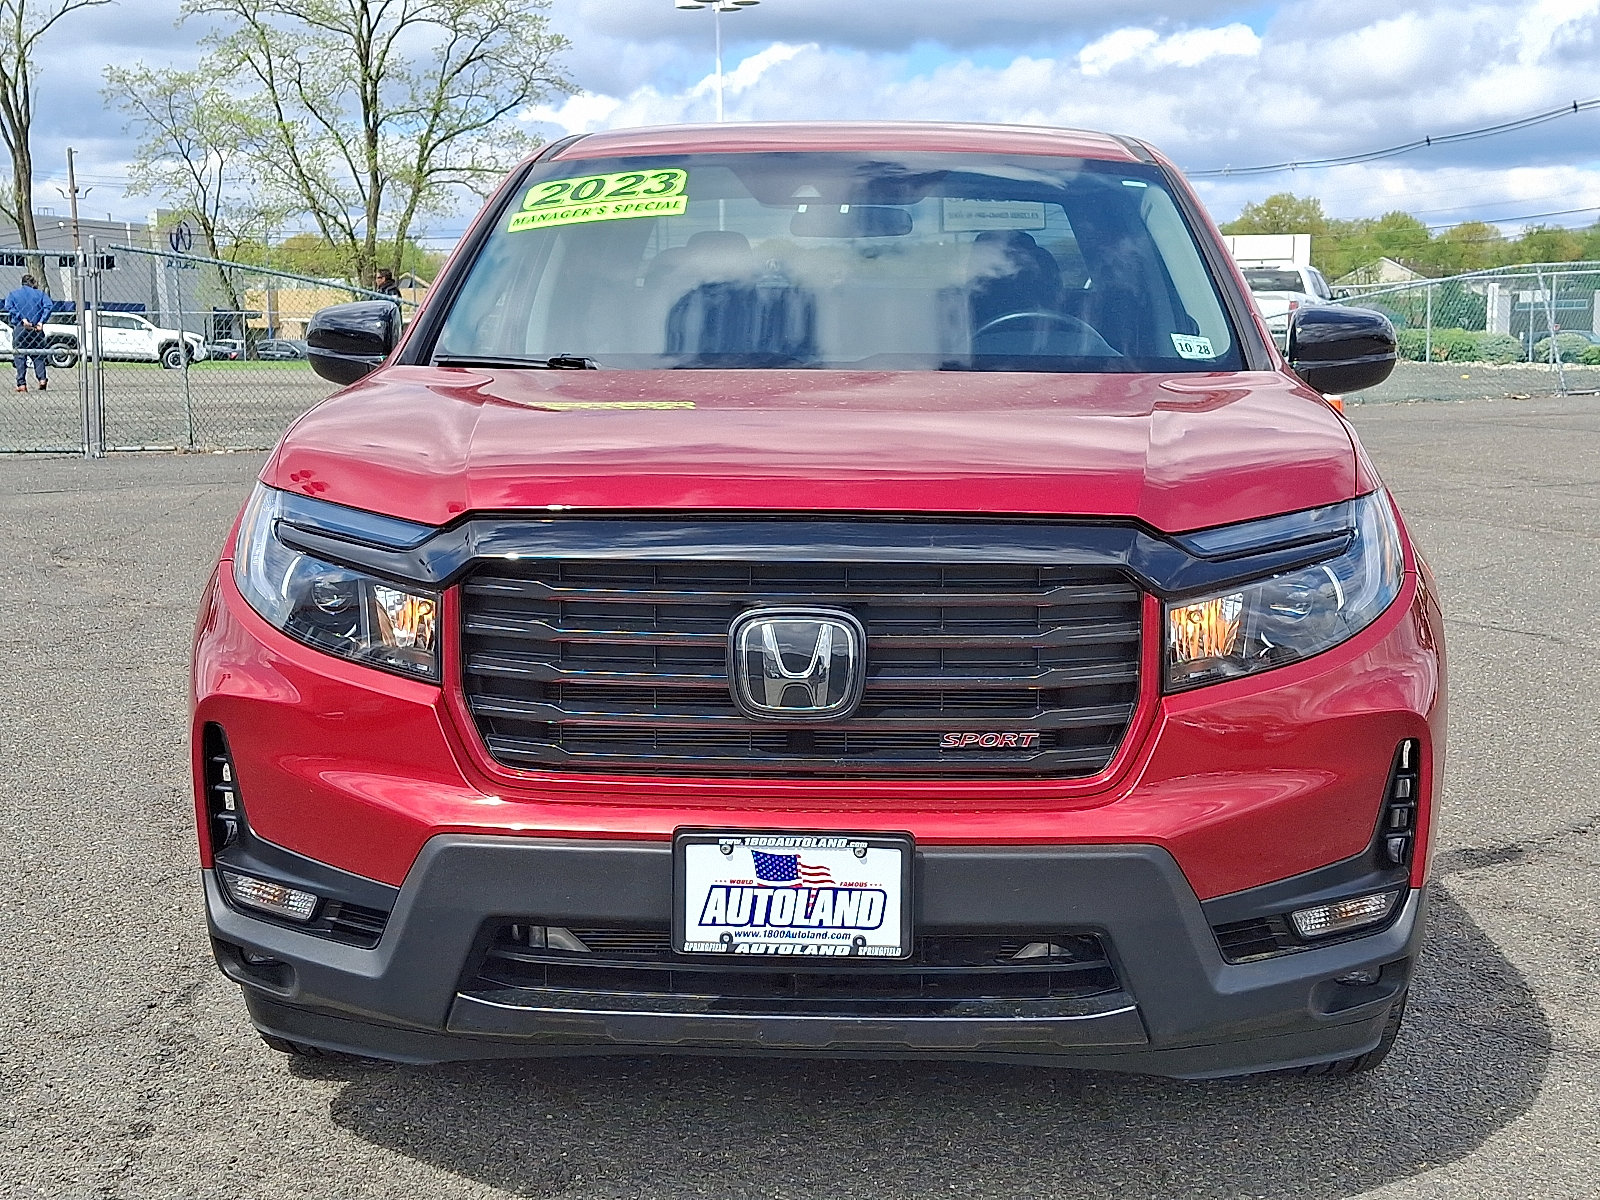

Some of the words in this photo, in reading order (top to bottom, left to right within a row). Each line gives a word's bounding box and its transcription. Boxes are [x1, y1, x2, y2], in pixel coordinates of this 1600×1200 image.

[529, 172, 682, 207] 2023
[512, 204, 605, 227] MANAGER'S
[612, 200, 682, 214] SPECIAL
[1178, 342, 1193, 353] 10
[1196, 344, 1211, 355] 28
[940, 732, 1040, 748] SPORT
[698, 885, 888, 931] AUTOLAND
[734, 930, 851, 941] www.1800Autoland.com
[734, 943, 851, 956] AUTOLAND
[857, 946, 902, 957] SPRINGFIELD
